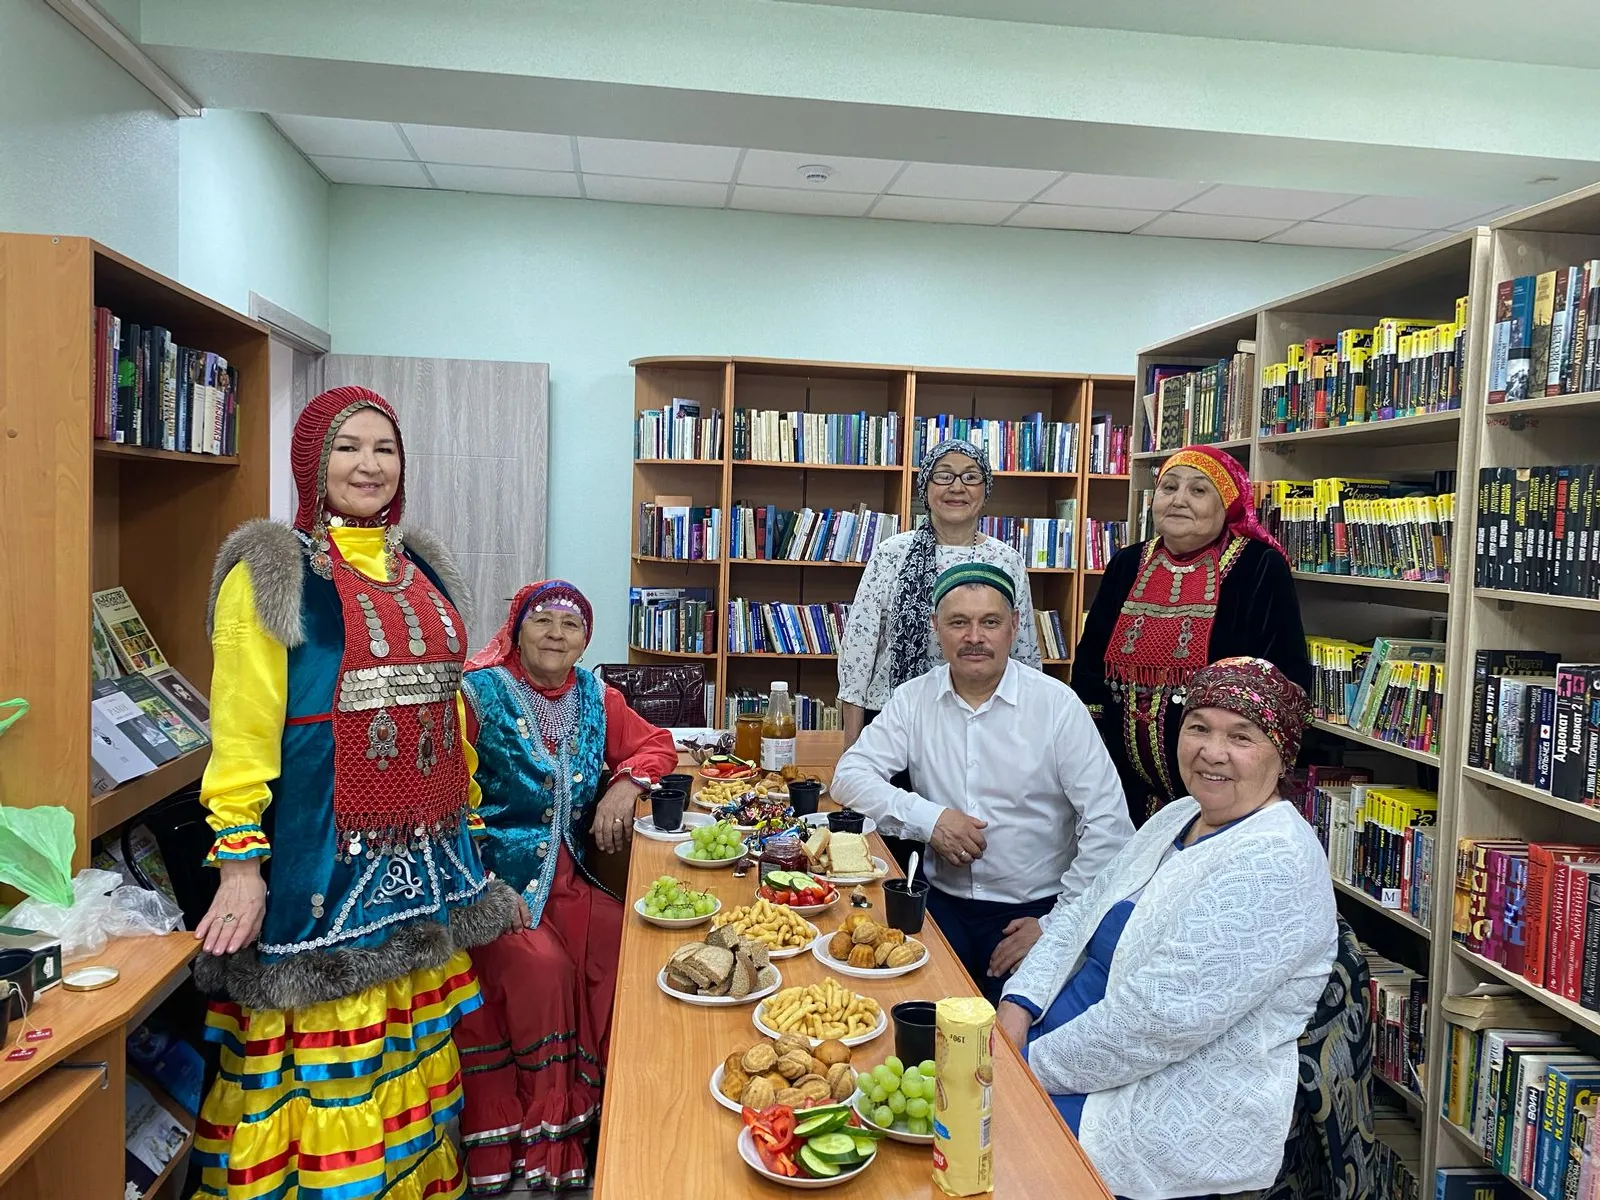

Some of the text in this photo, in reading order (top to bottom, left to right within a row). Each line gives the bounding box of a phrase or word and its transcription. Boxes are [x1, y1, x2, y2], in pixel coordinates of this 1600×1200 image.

[1574, 309, 1586, 364] АБДУЛЛАЕВ
[1486, 685, 1496, 713] МЕНТ
[1553, 713, 1568, 762] Адвокат
[1569, 702, 1583, 754] Адвокат 2
[1541, 741, 1550, 776] КОЛЫЧЕВ
[1555, 868, 1565, 931] МАРИНИНА
[1573, 876, 1584, 939] МАРИНИНА
[1586, 951, 1597, 996] АЛЕКСАНДРА
[1528, 1089, 1538, 1120] ВОИН
[1545, 1073, 1557, 1118] СЕРОВА
[1556, 1081, 1568, 1127] СЕРОВА
[1543, 1119, 1553, 1132] М.
[1554, 1127, 1563, 1141] М.
